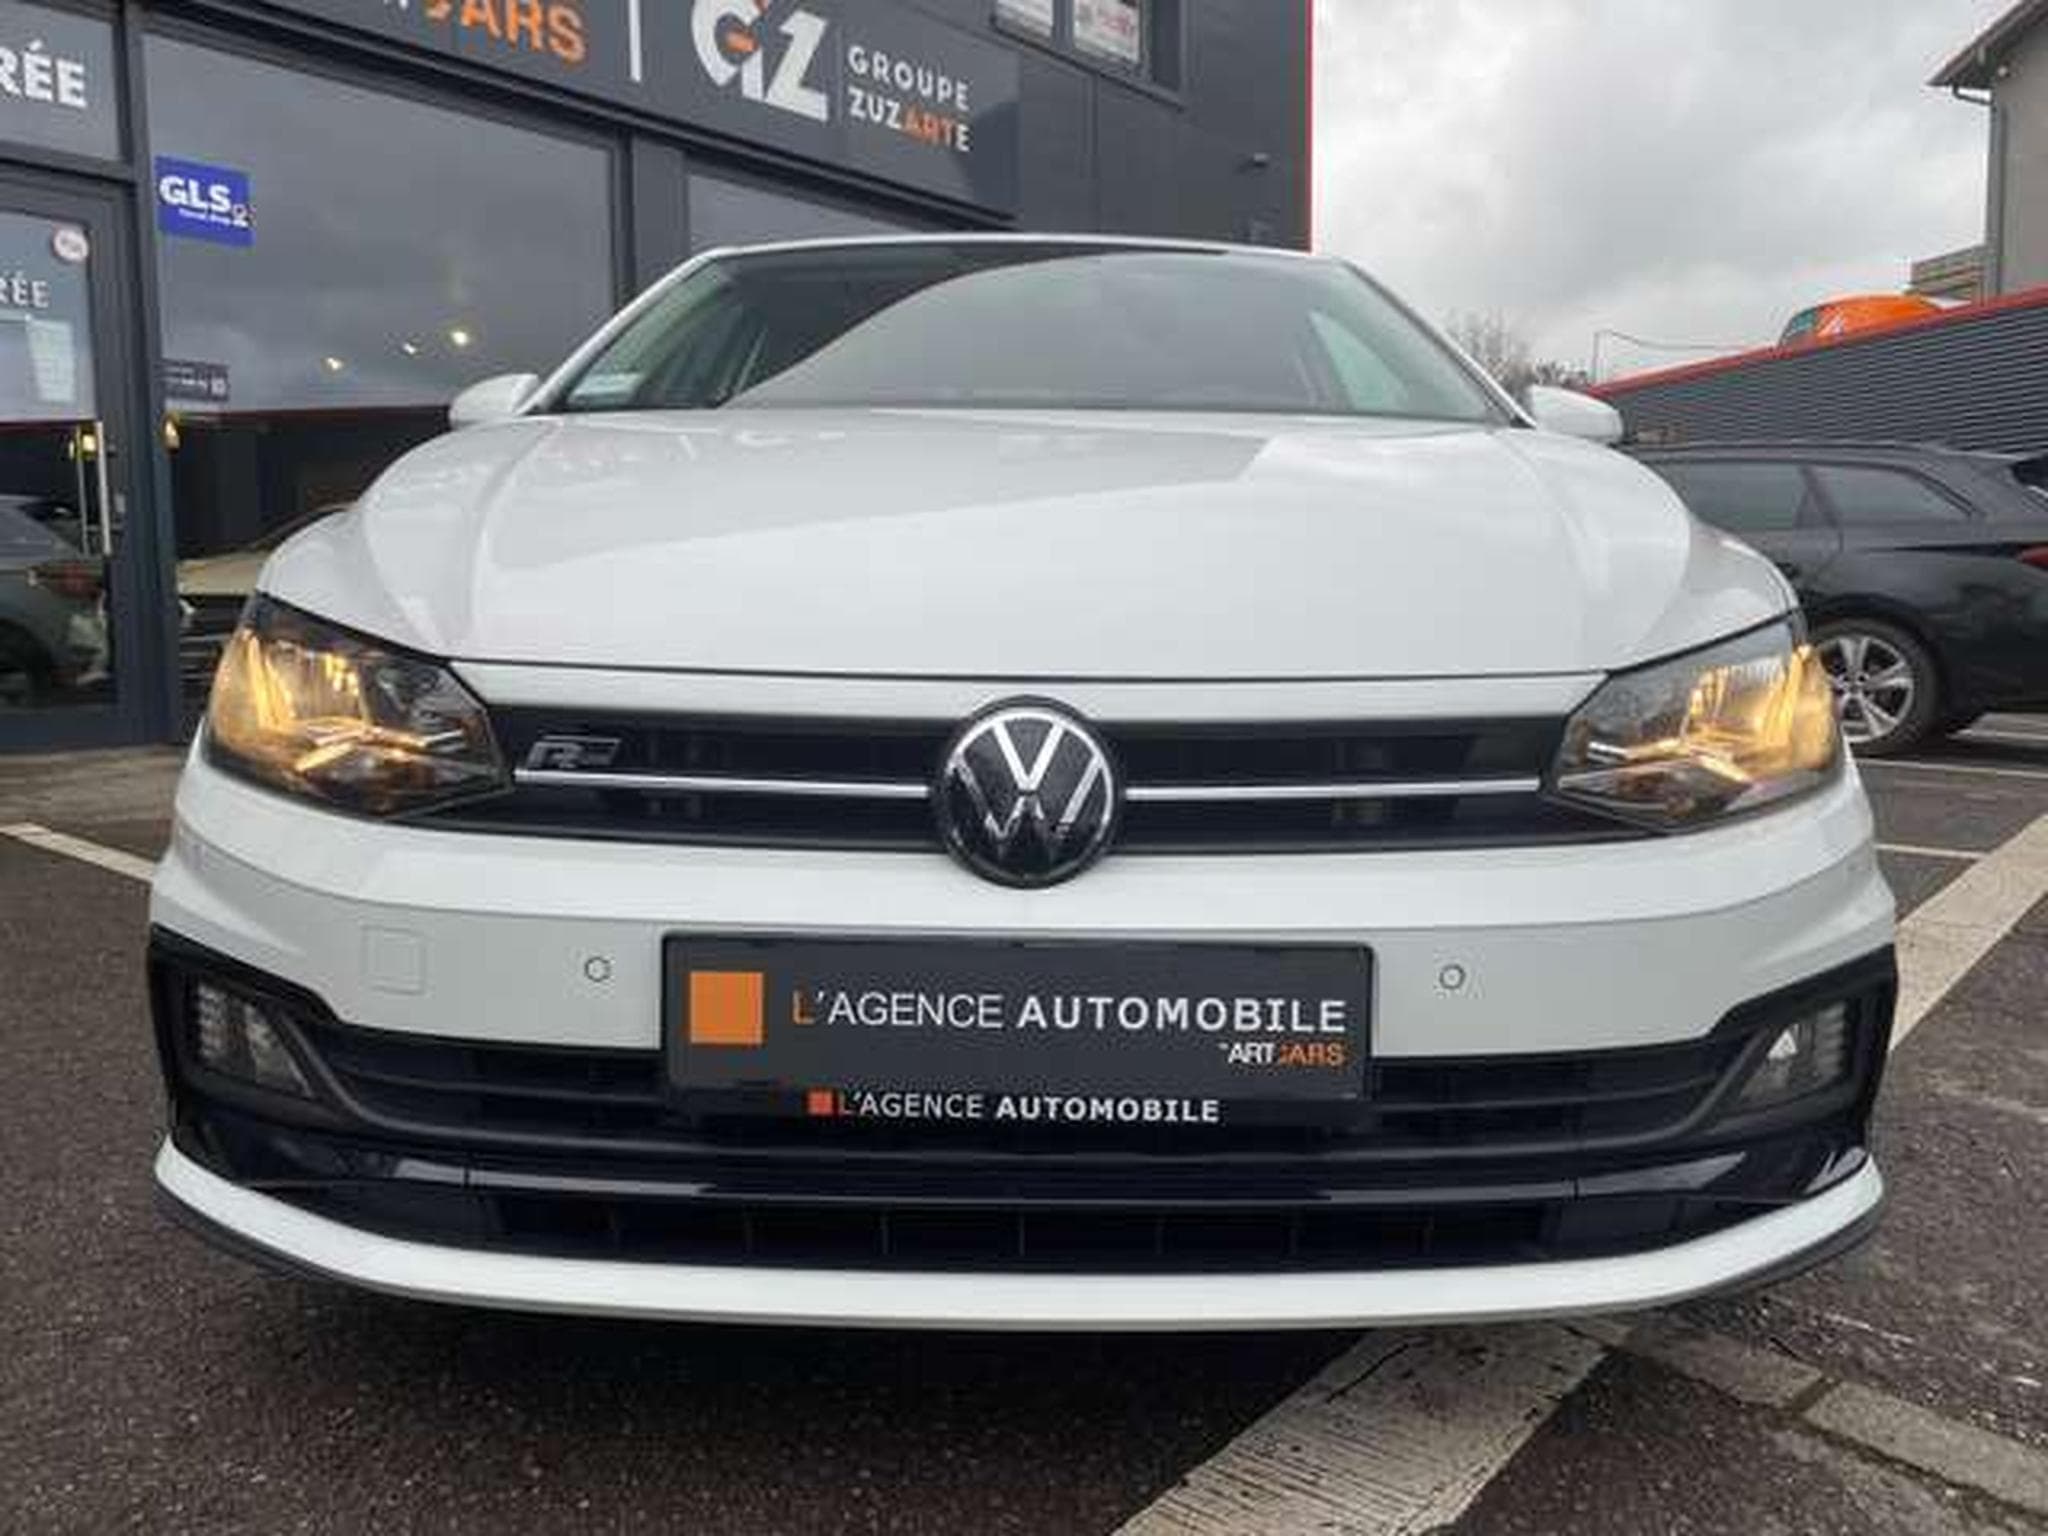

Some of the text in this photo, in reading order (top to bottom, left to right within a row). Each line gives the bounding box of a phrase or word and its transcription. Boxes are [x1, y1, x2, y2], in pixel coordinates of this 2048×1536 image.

[848, 45, 970, 112] GROUPE
[848, 86, 971, 152] ZUZARTE
[159, 174, 232, 213] GLS
[791, 990, 1347, 1032] L'AGENCE AUTOMOBILE
[838, 1092, 1221, 1123] L'AGENCE AUTOMOBILE
